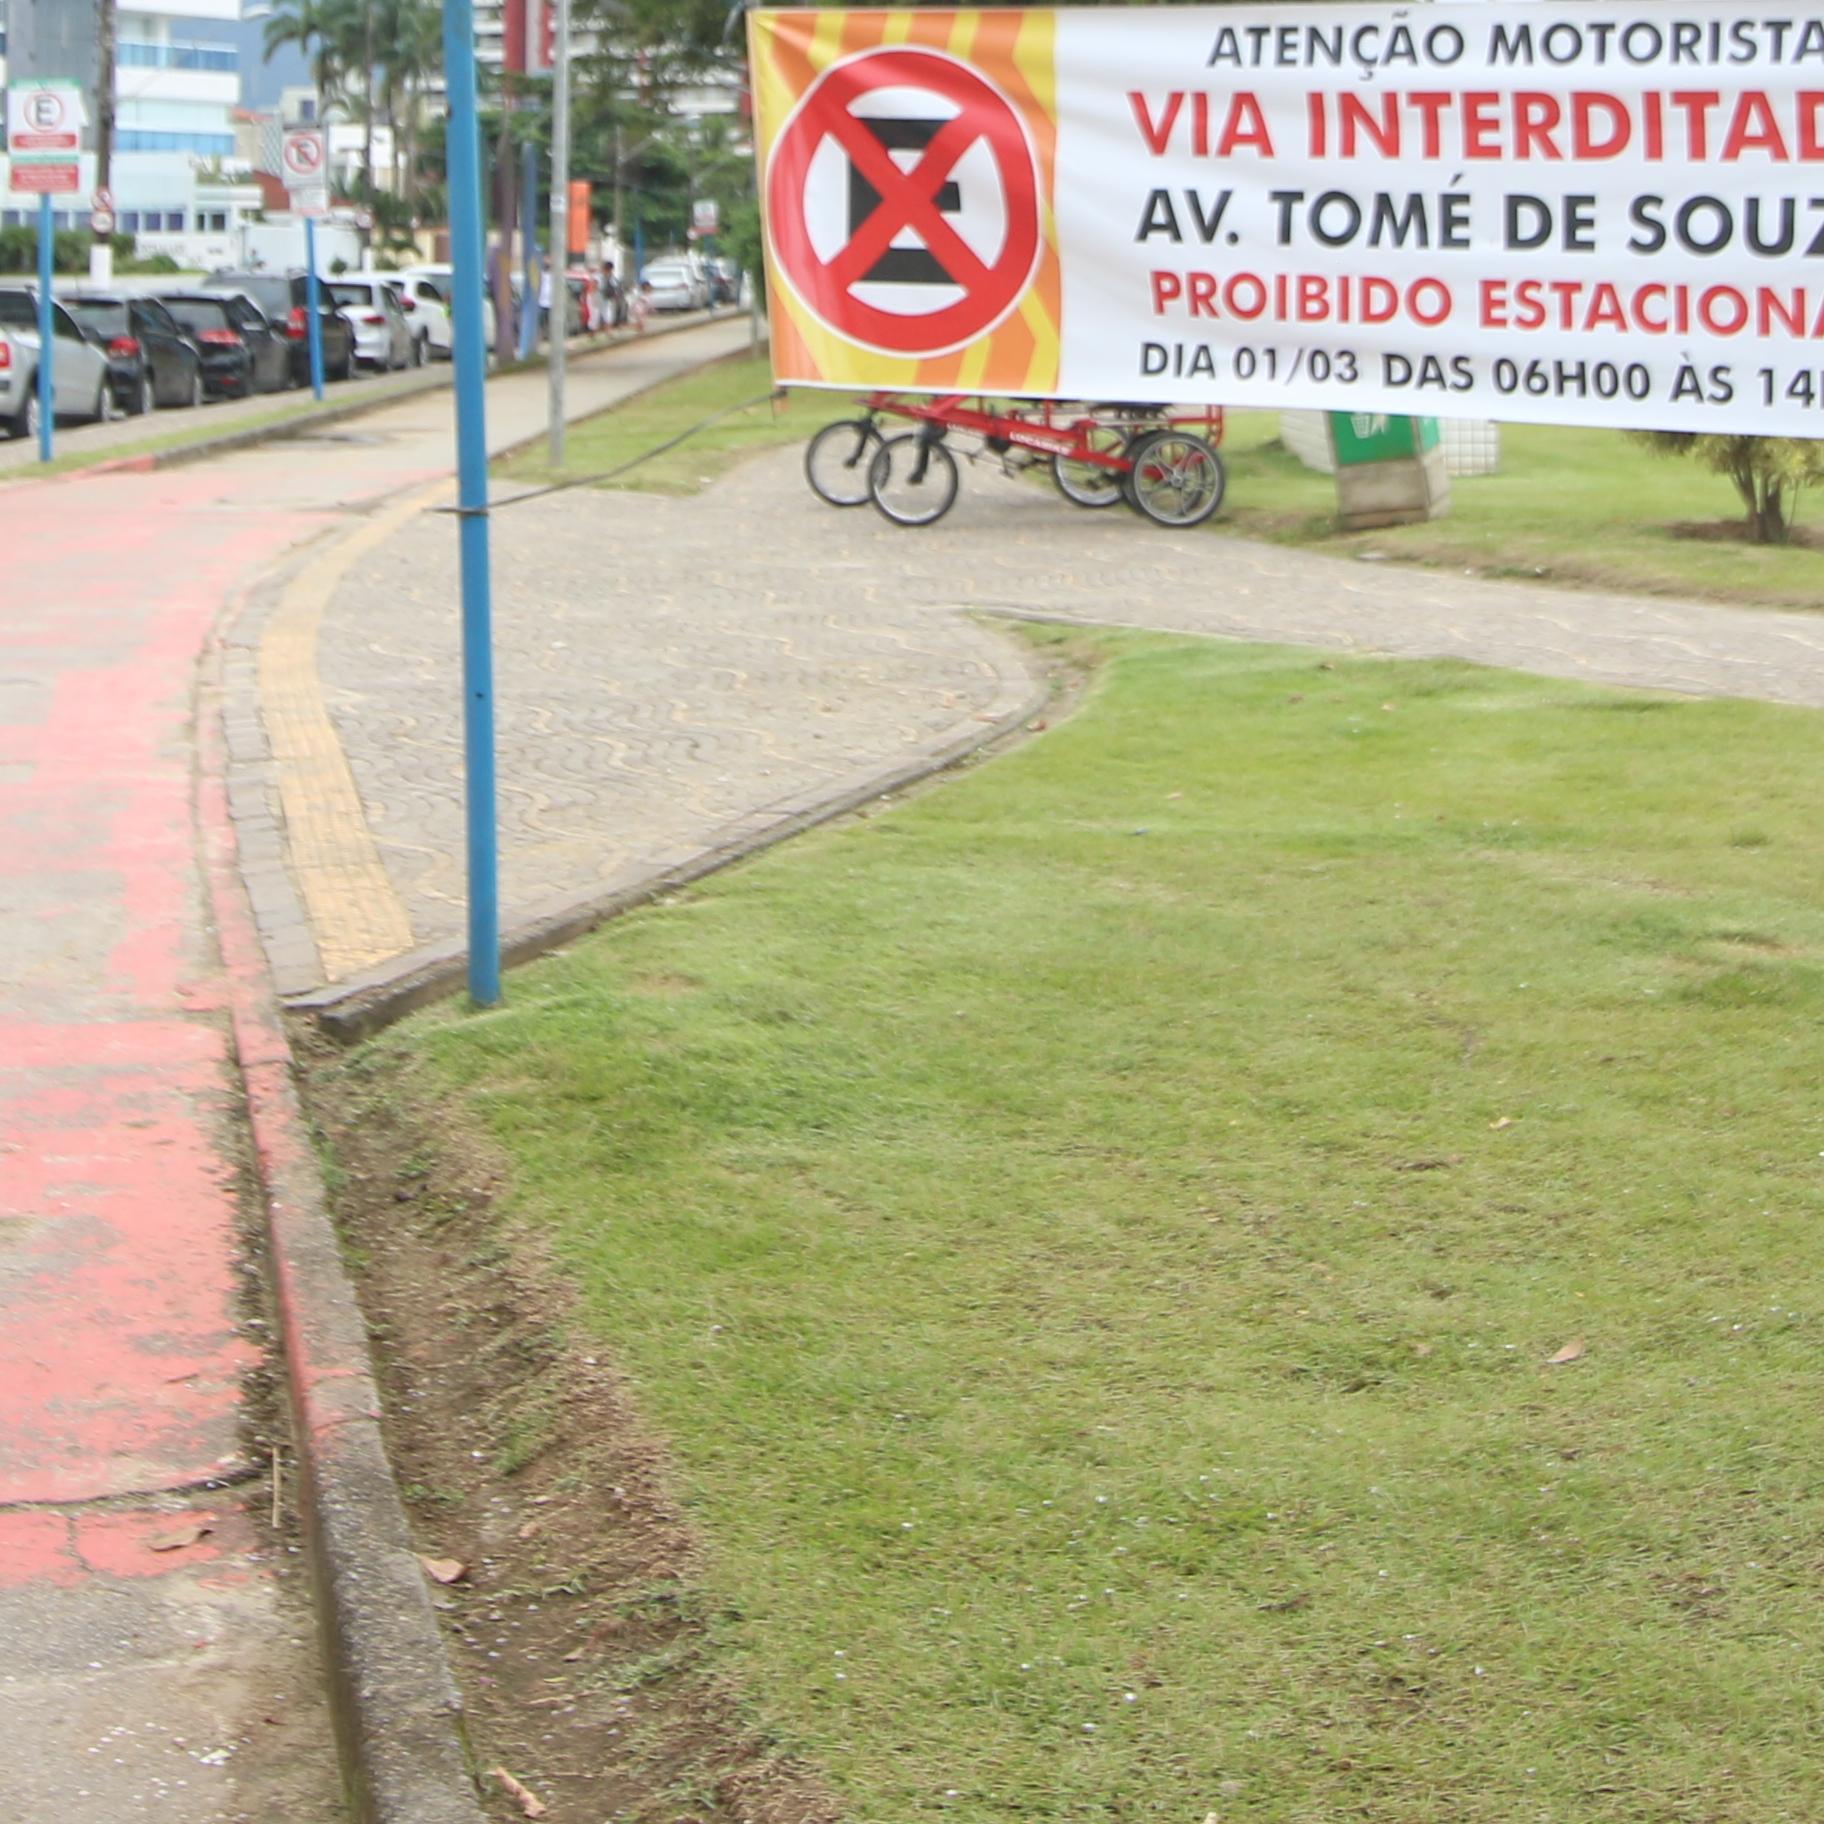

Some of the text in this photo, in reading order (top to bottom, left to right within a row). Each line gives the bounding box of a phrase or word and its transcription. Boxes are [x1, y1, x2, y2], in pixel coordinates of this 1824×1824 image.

[1206, 10, 1465, 80] ATENÇÃO
[35, 96, 55, 126] E
[1127, 90, 1275, 158] VIA
[1134, 188, 1241, 246] AV.
[1267, 172, 1472, 251] TOMÉ
[1503, 194, 1596, 253] DE
[1149, 271, 1453, 327] PROIBIDO
[1139, 342, 1216, 379] DIA
[1232, 347, 1360, 387] 01/03
[1381, 353, 1475, 393] DAS
[1491, 358, 1651, 402] 06H00
[1668, 353, 1734, 405] ÀS
